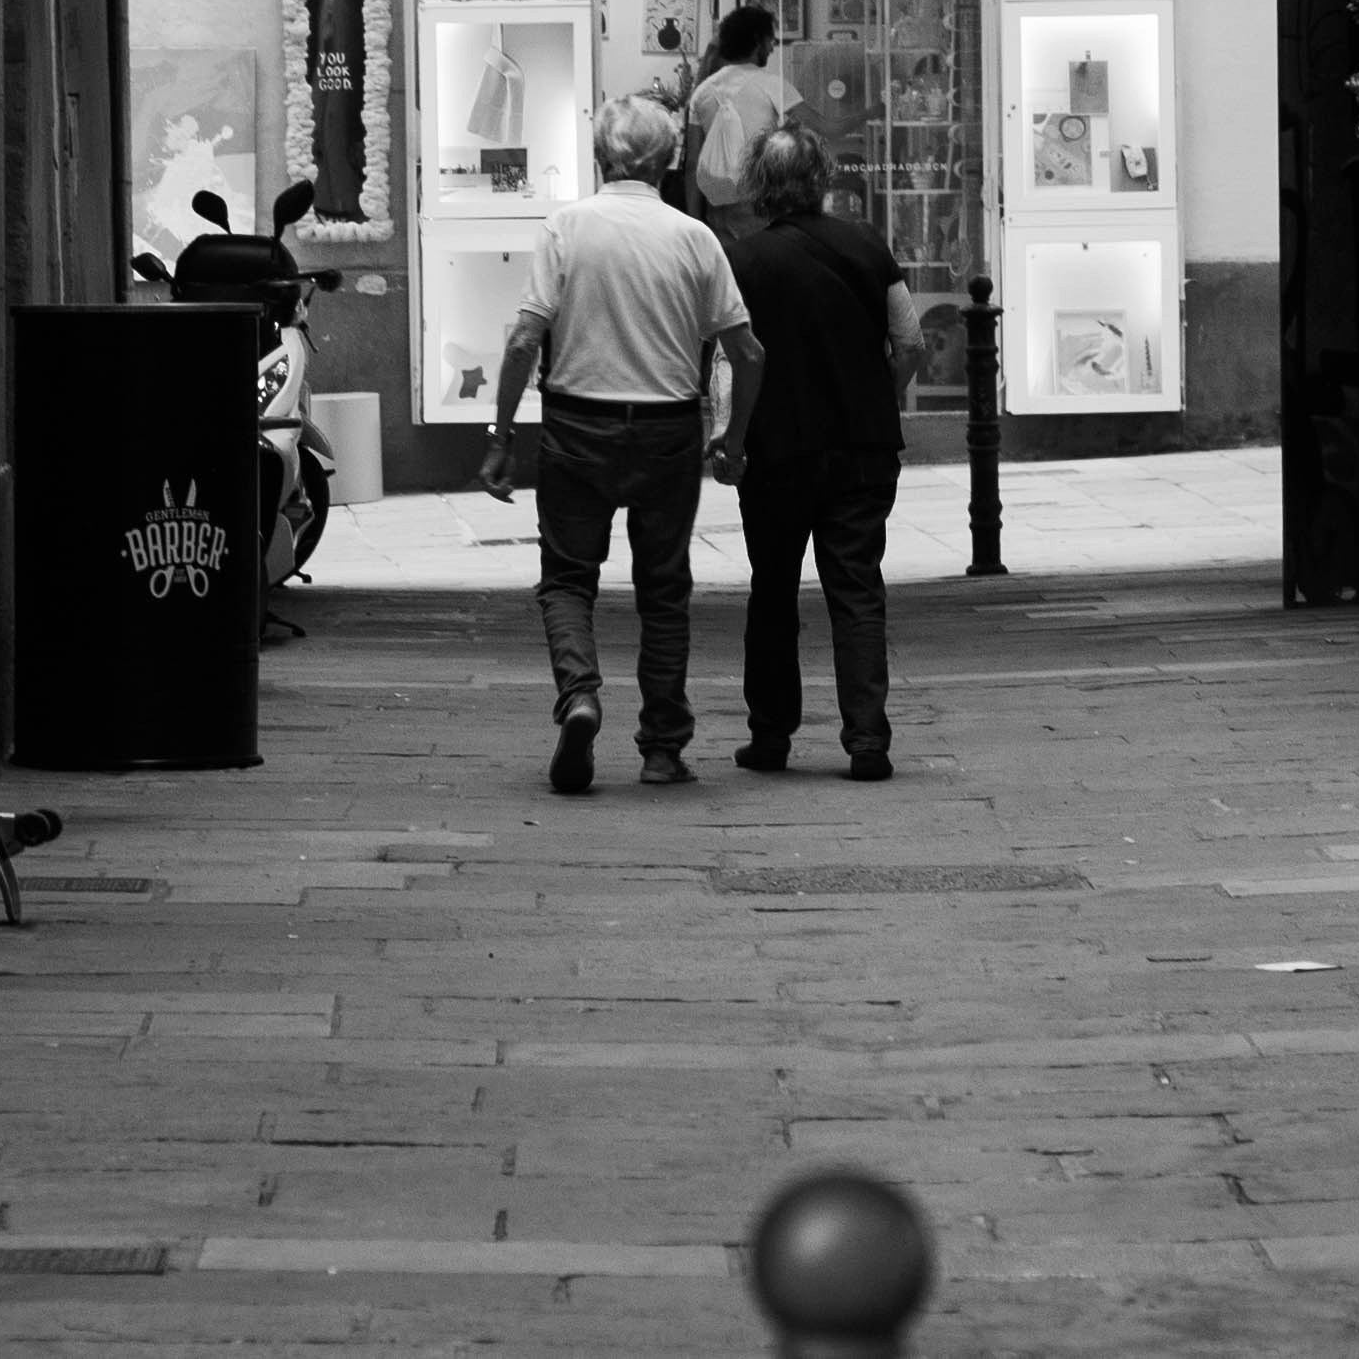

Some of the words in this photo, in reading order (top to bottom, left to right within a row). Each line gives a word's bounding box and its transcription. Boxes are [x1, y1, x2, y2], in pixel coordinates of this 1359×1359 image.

[318, 52, 346, 65] YOU
[316, 66, 350, 77] LOOK
[123, 519, 227, 573] BARBER
